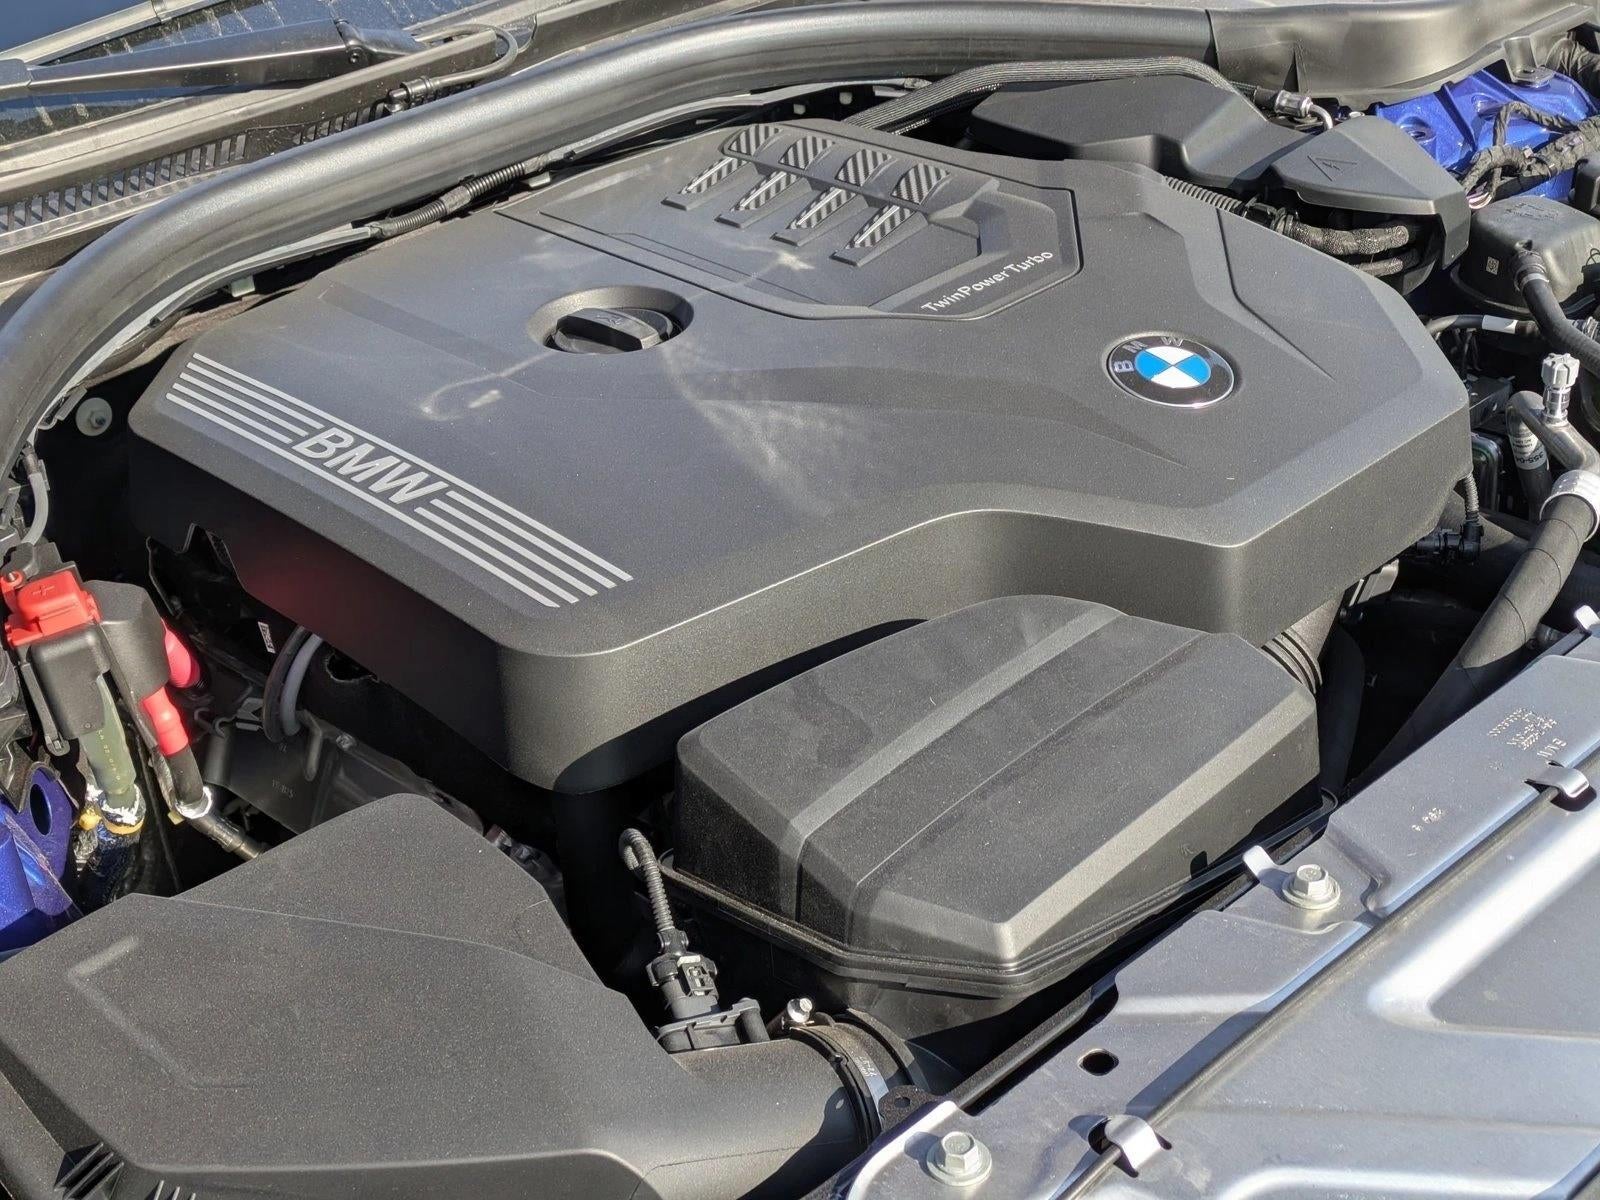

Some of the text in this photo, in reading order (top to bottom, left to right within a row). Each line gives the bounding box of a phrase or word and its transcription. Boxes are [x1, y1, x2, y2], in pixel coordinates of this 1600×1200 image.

[920, 251, 1054, 312] TwinPower Turbo
[1113, 336, 1184, 373] BMW
[291, 427, 449, 505] BMW
